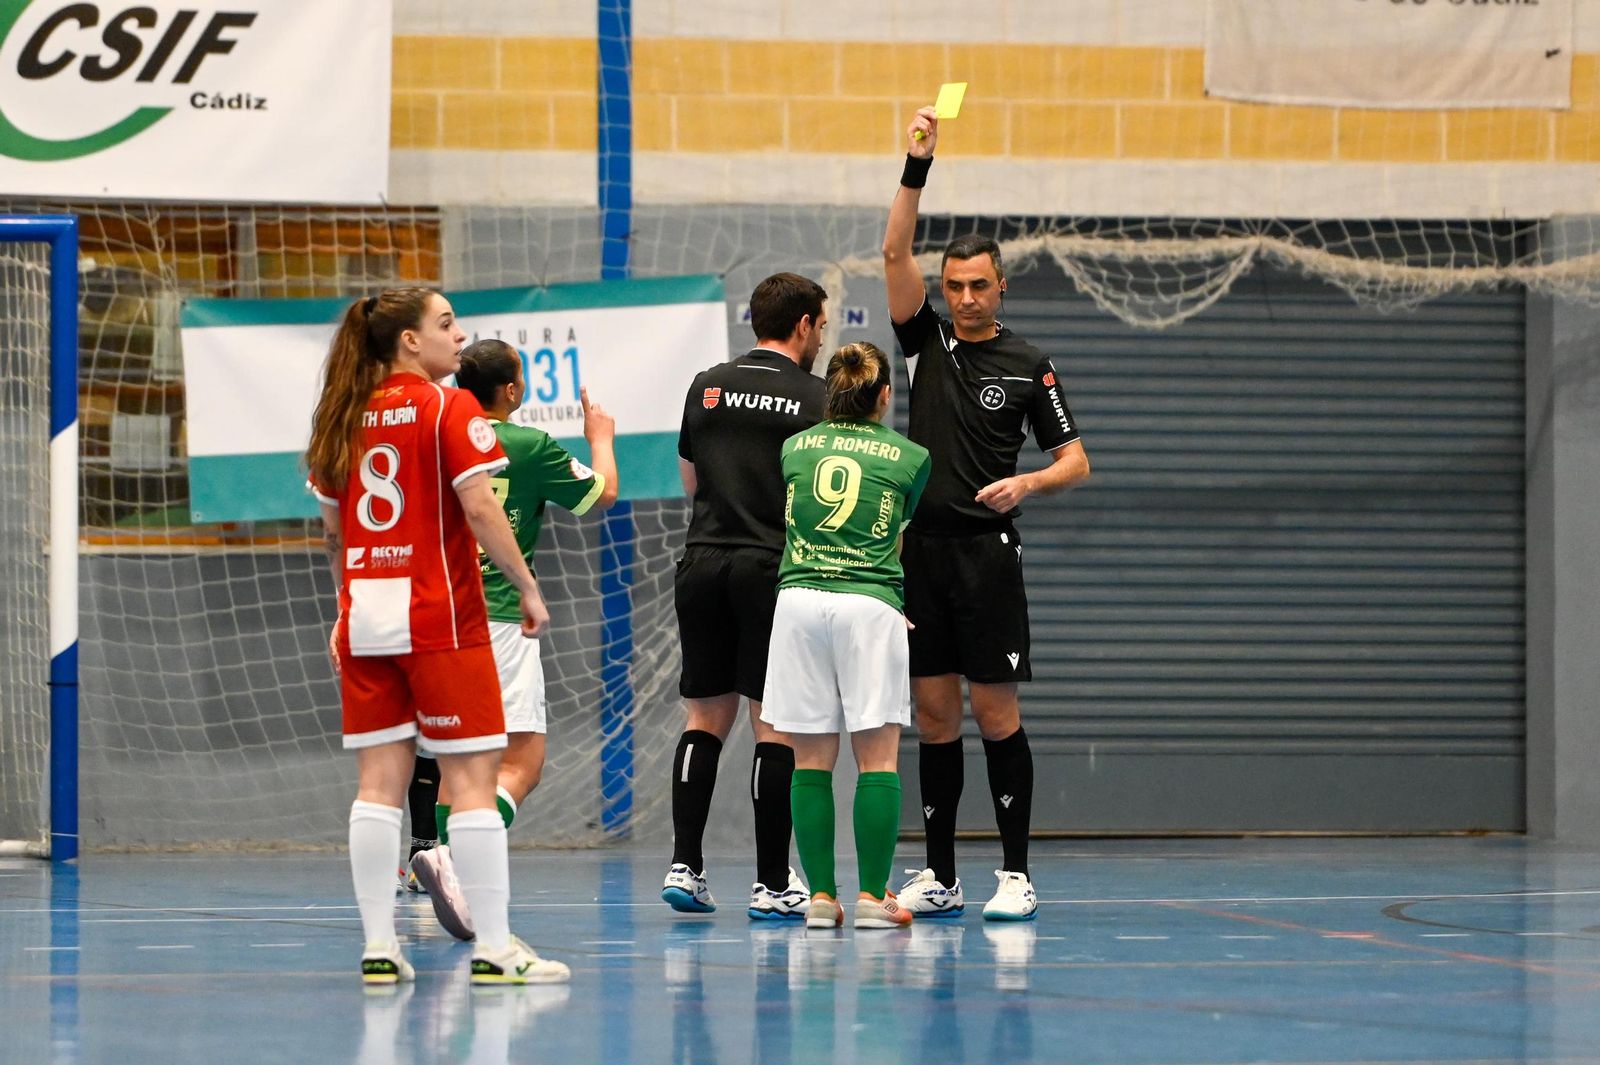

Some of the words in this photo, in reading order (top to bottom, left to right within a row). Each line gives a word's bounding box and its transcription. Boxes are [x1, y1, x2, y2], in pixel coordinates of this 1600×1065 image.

[17, 3, 258, 84] CSIF
[190, 92, 268, 110] Cádiz
[472, 326, 577, 345] ATURA
[362, 410, 378, 428] TH
[520, 404, 584, 423] CULTURA
[793, 435, 827, 452] AME
[831, 436, 901, 462] ROMERO
[356, 443, 404, 532] 8
[813, 455, 863, 533] 9
[804, 542, 867, 557] Ayuntamiento
